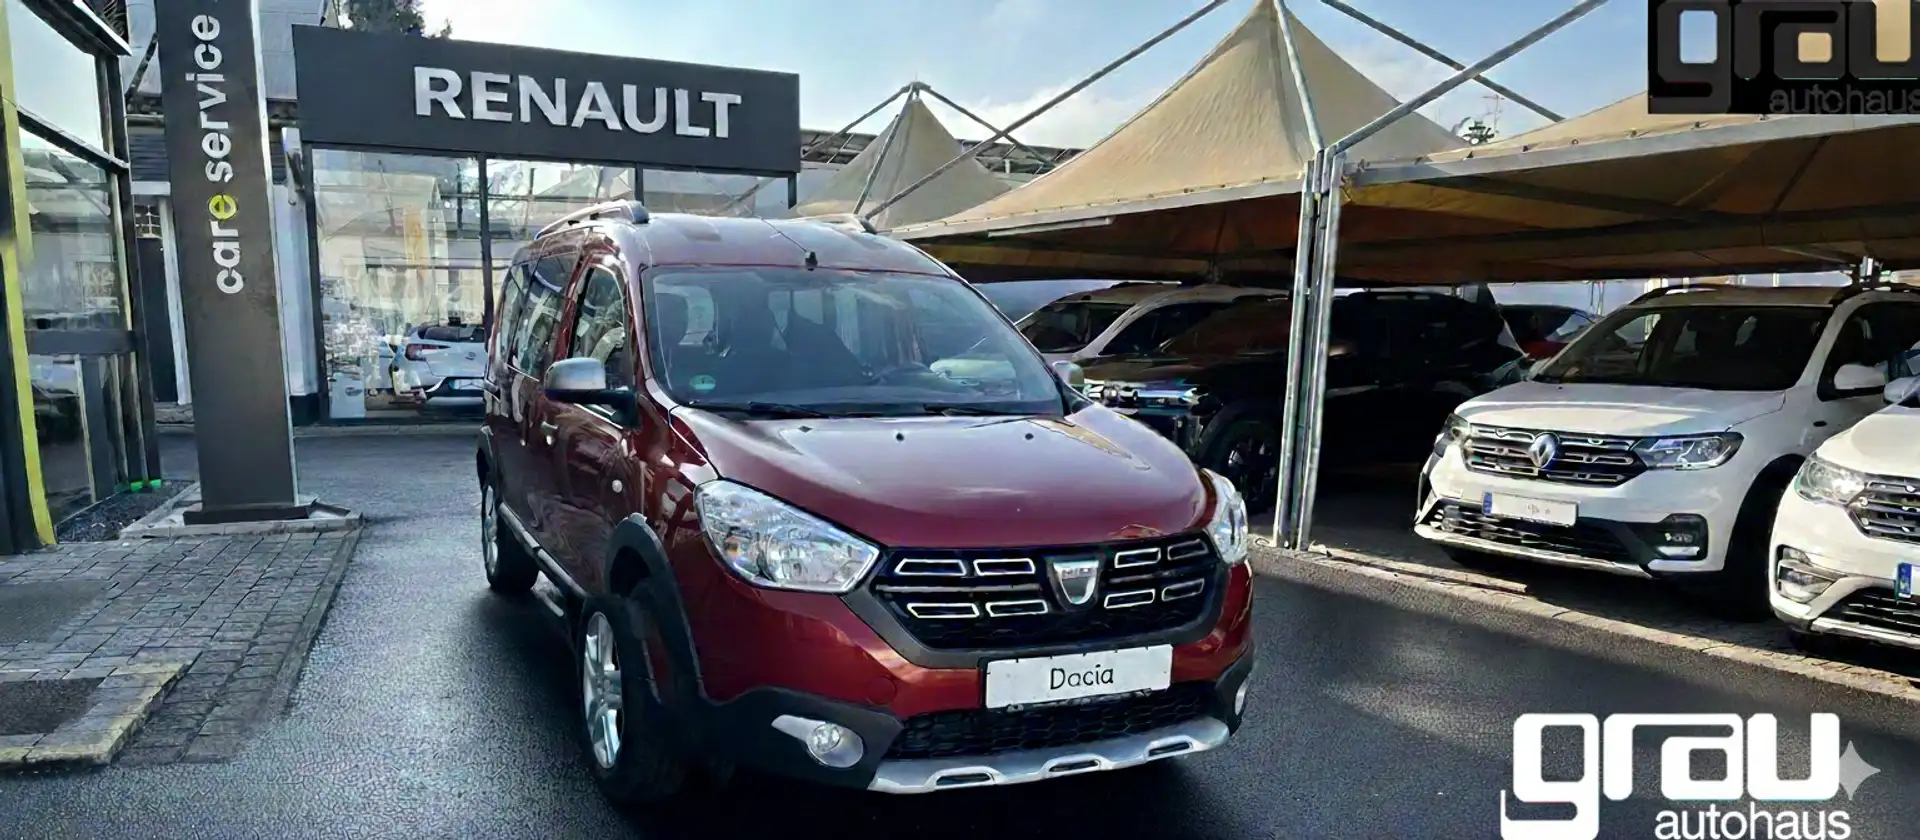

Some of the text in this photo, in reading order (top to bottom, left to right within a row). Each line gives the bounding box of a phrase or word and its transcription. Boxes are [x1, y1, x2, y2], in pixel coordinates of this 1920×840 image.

[414, 66, 742, 139] RENAULT
[185, 14, 244, 294] care service
[1050, 663, 1114, 690] Dacia
